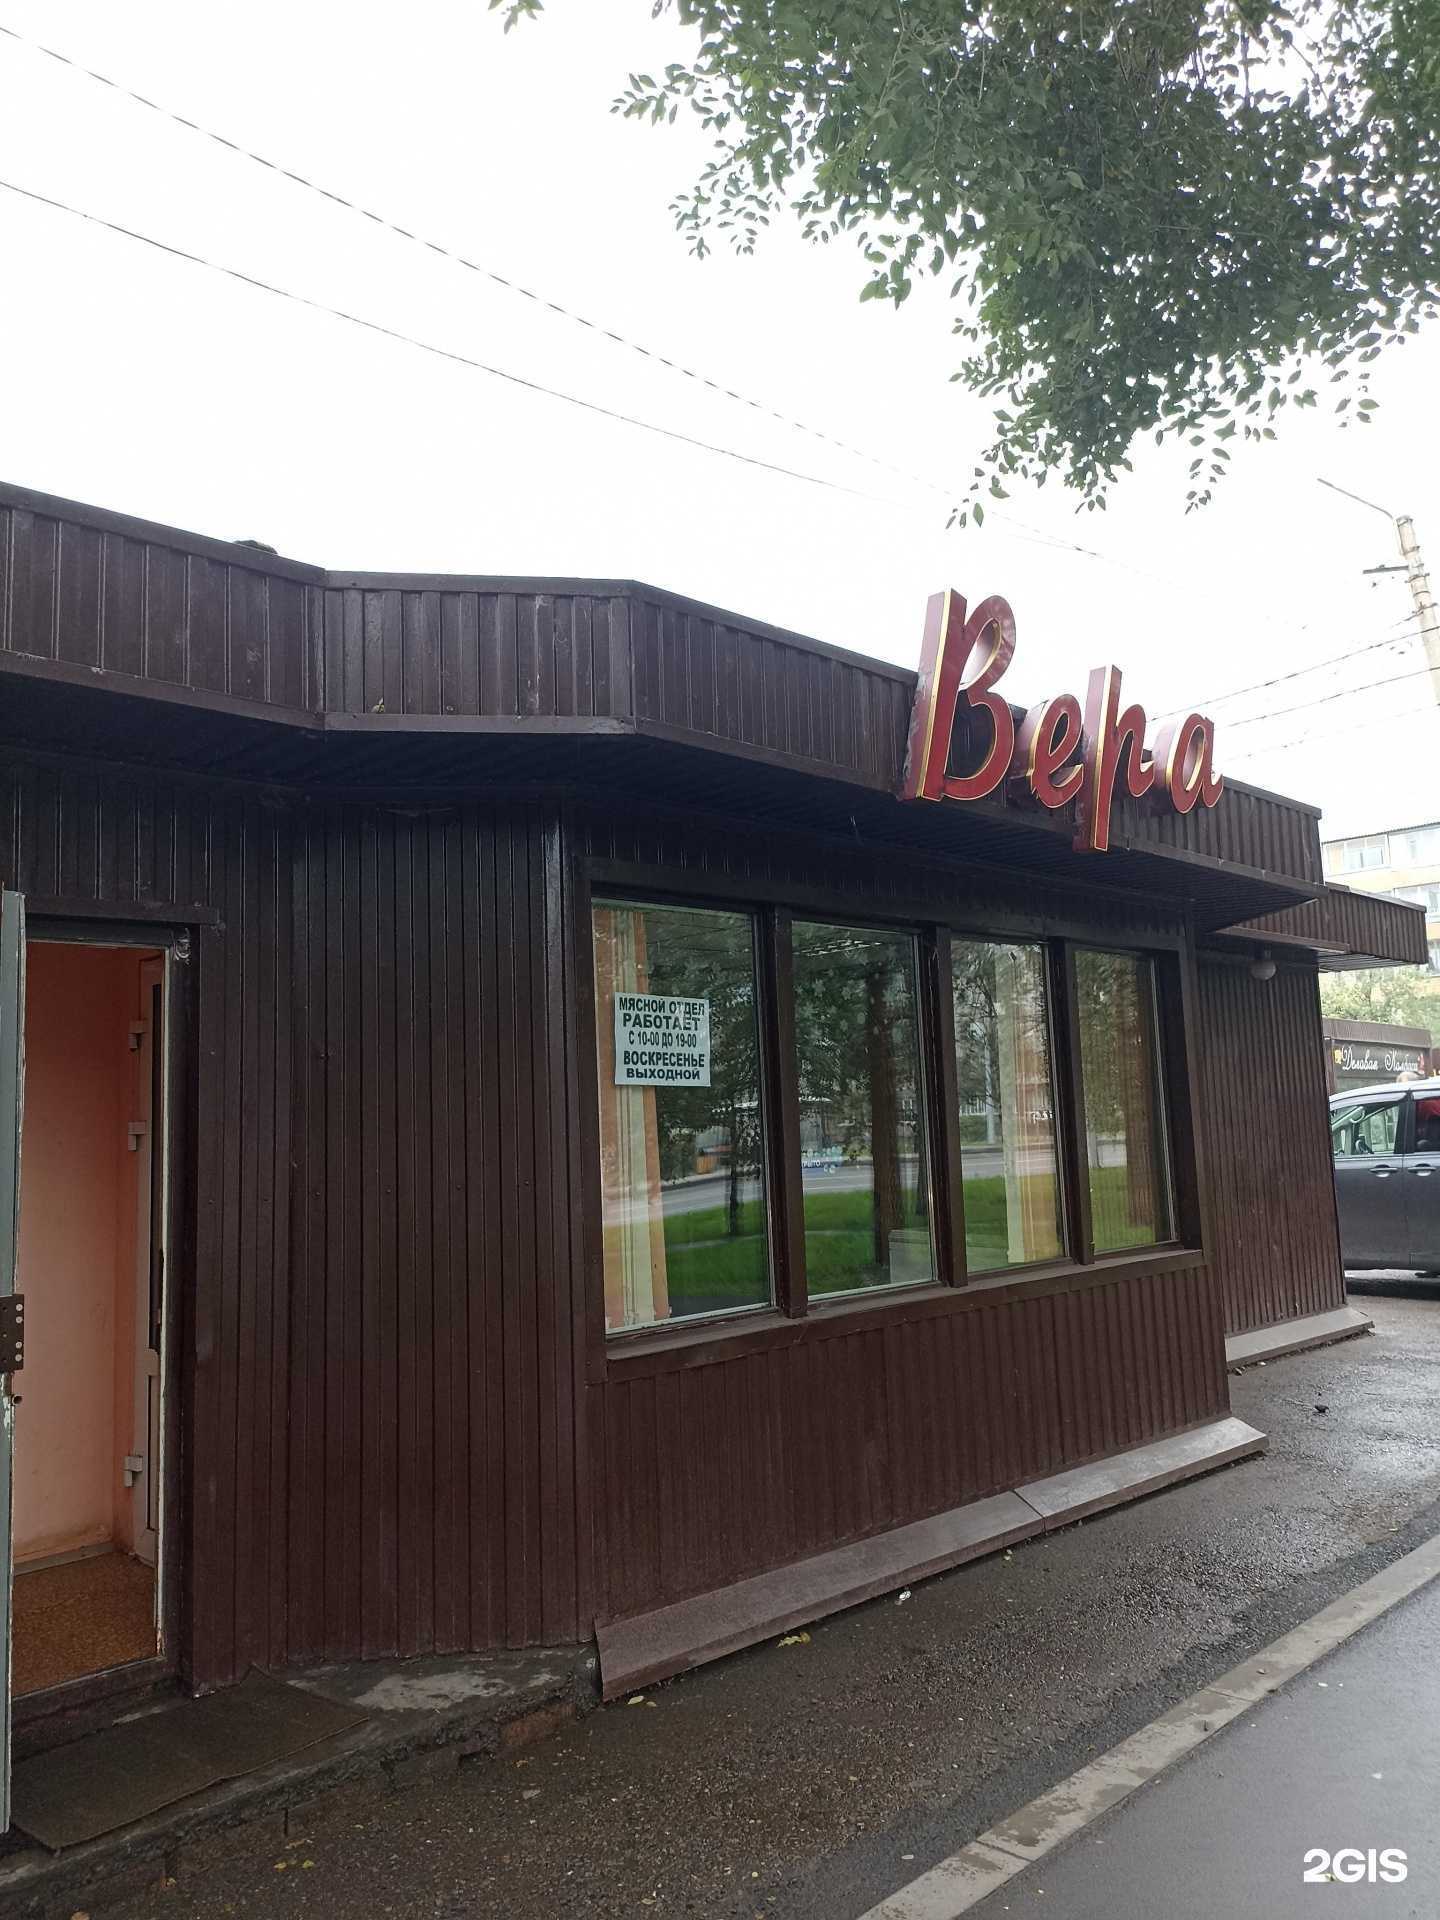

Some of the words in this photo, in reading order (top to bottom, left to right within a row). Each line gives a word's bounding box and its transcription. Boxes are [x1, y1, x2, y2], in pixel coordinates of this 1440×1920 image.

[619, 997, 666, 1014] МЯСНОЙ
[669, 1000, 705, 1017] ОТДЕЛ
[622, 1013, 701, 1031] РАБОТАЕТ
[628, 1030, 635, 1045] С
[637, 1031, 660, 1046] 10-00
[661, 1033, 673, 1048] ДО
[675, 1033, 697, 1048] 19-00
[623, 1050, 705, 1068] ВОСКРЕСЕНЬЕ
[626, 1067, 701, 1081] ВЫХОДНОЙ
